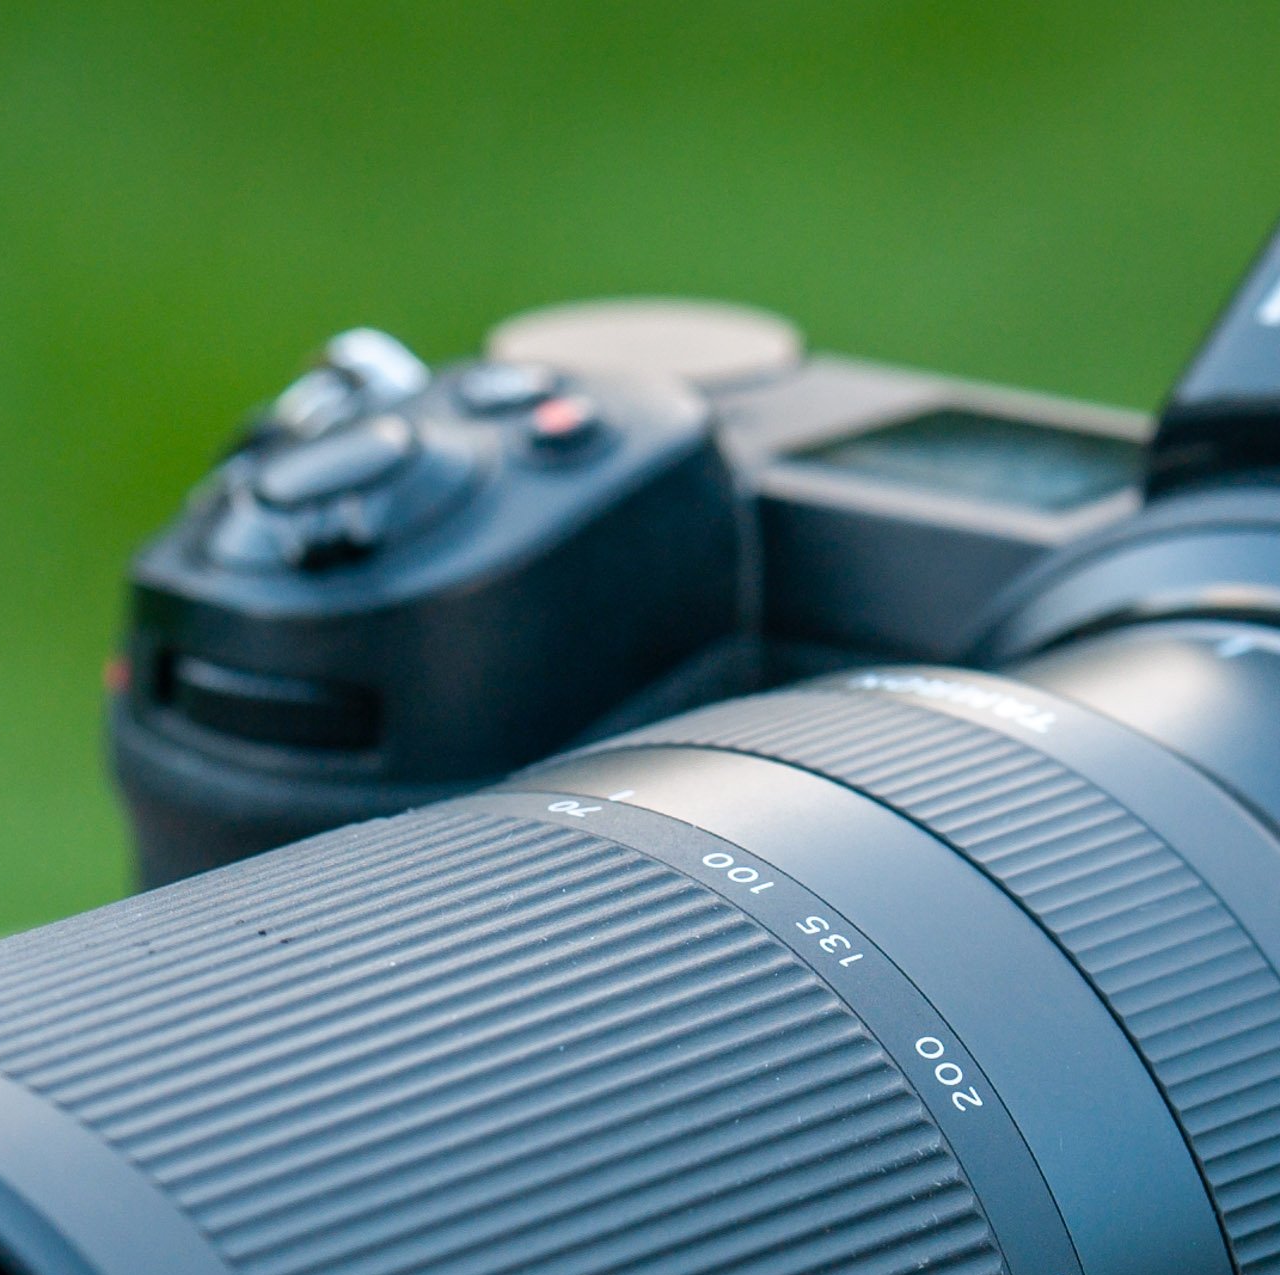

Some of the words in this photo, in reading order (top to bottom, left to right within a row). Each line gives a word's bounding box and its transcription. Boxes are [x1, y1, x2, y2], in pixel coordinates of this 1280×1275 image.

[547, 800, 603, 818] 70
[702, 852, 775, 895] 100
[795, 915, 864, 968] 135
[915, 1036, 984, 1112] 200
